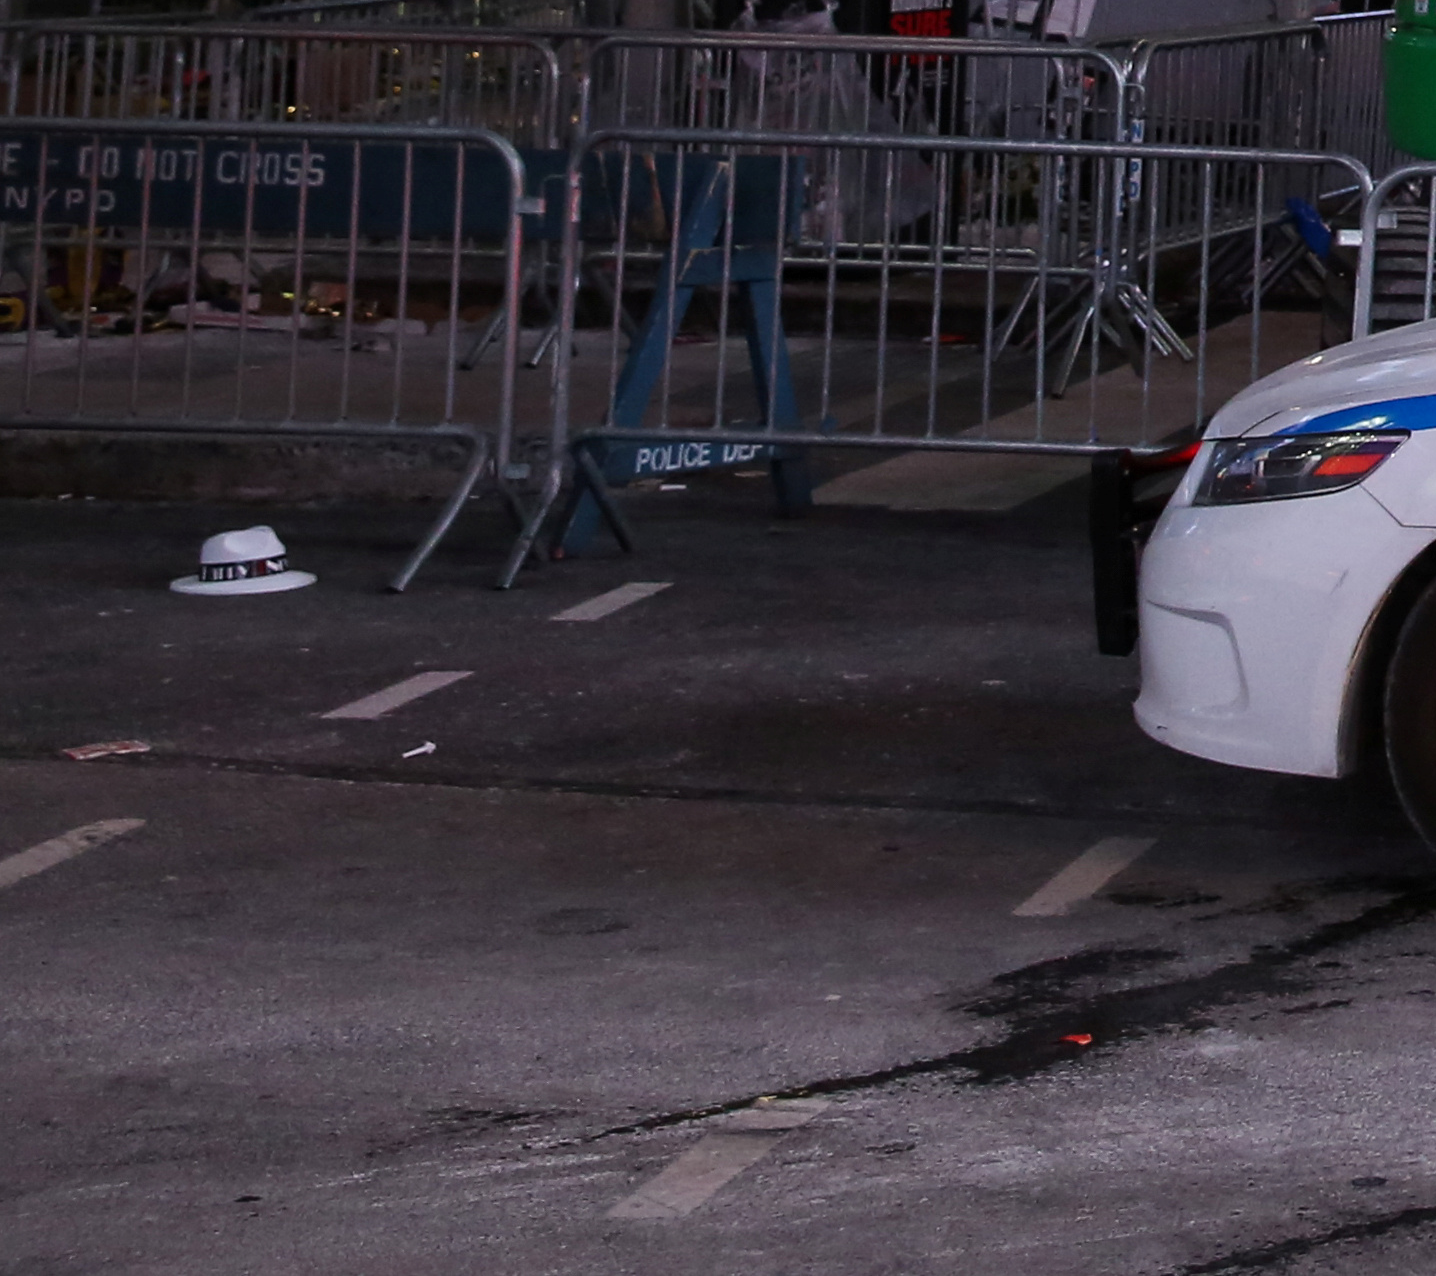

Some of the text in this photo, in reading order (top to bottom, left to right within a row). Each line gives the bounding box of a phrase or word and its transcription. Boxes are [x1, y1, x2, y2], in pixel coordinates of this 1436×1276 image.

[215, 150, 327, 187] CROSS
[1129, 119, 1145, 199] NPD
[635, 442, 712, 474] POLICE
